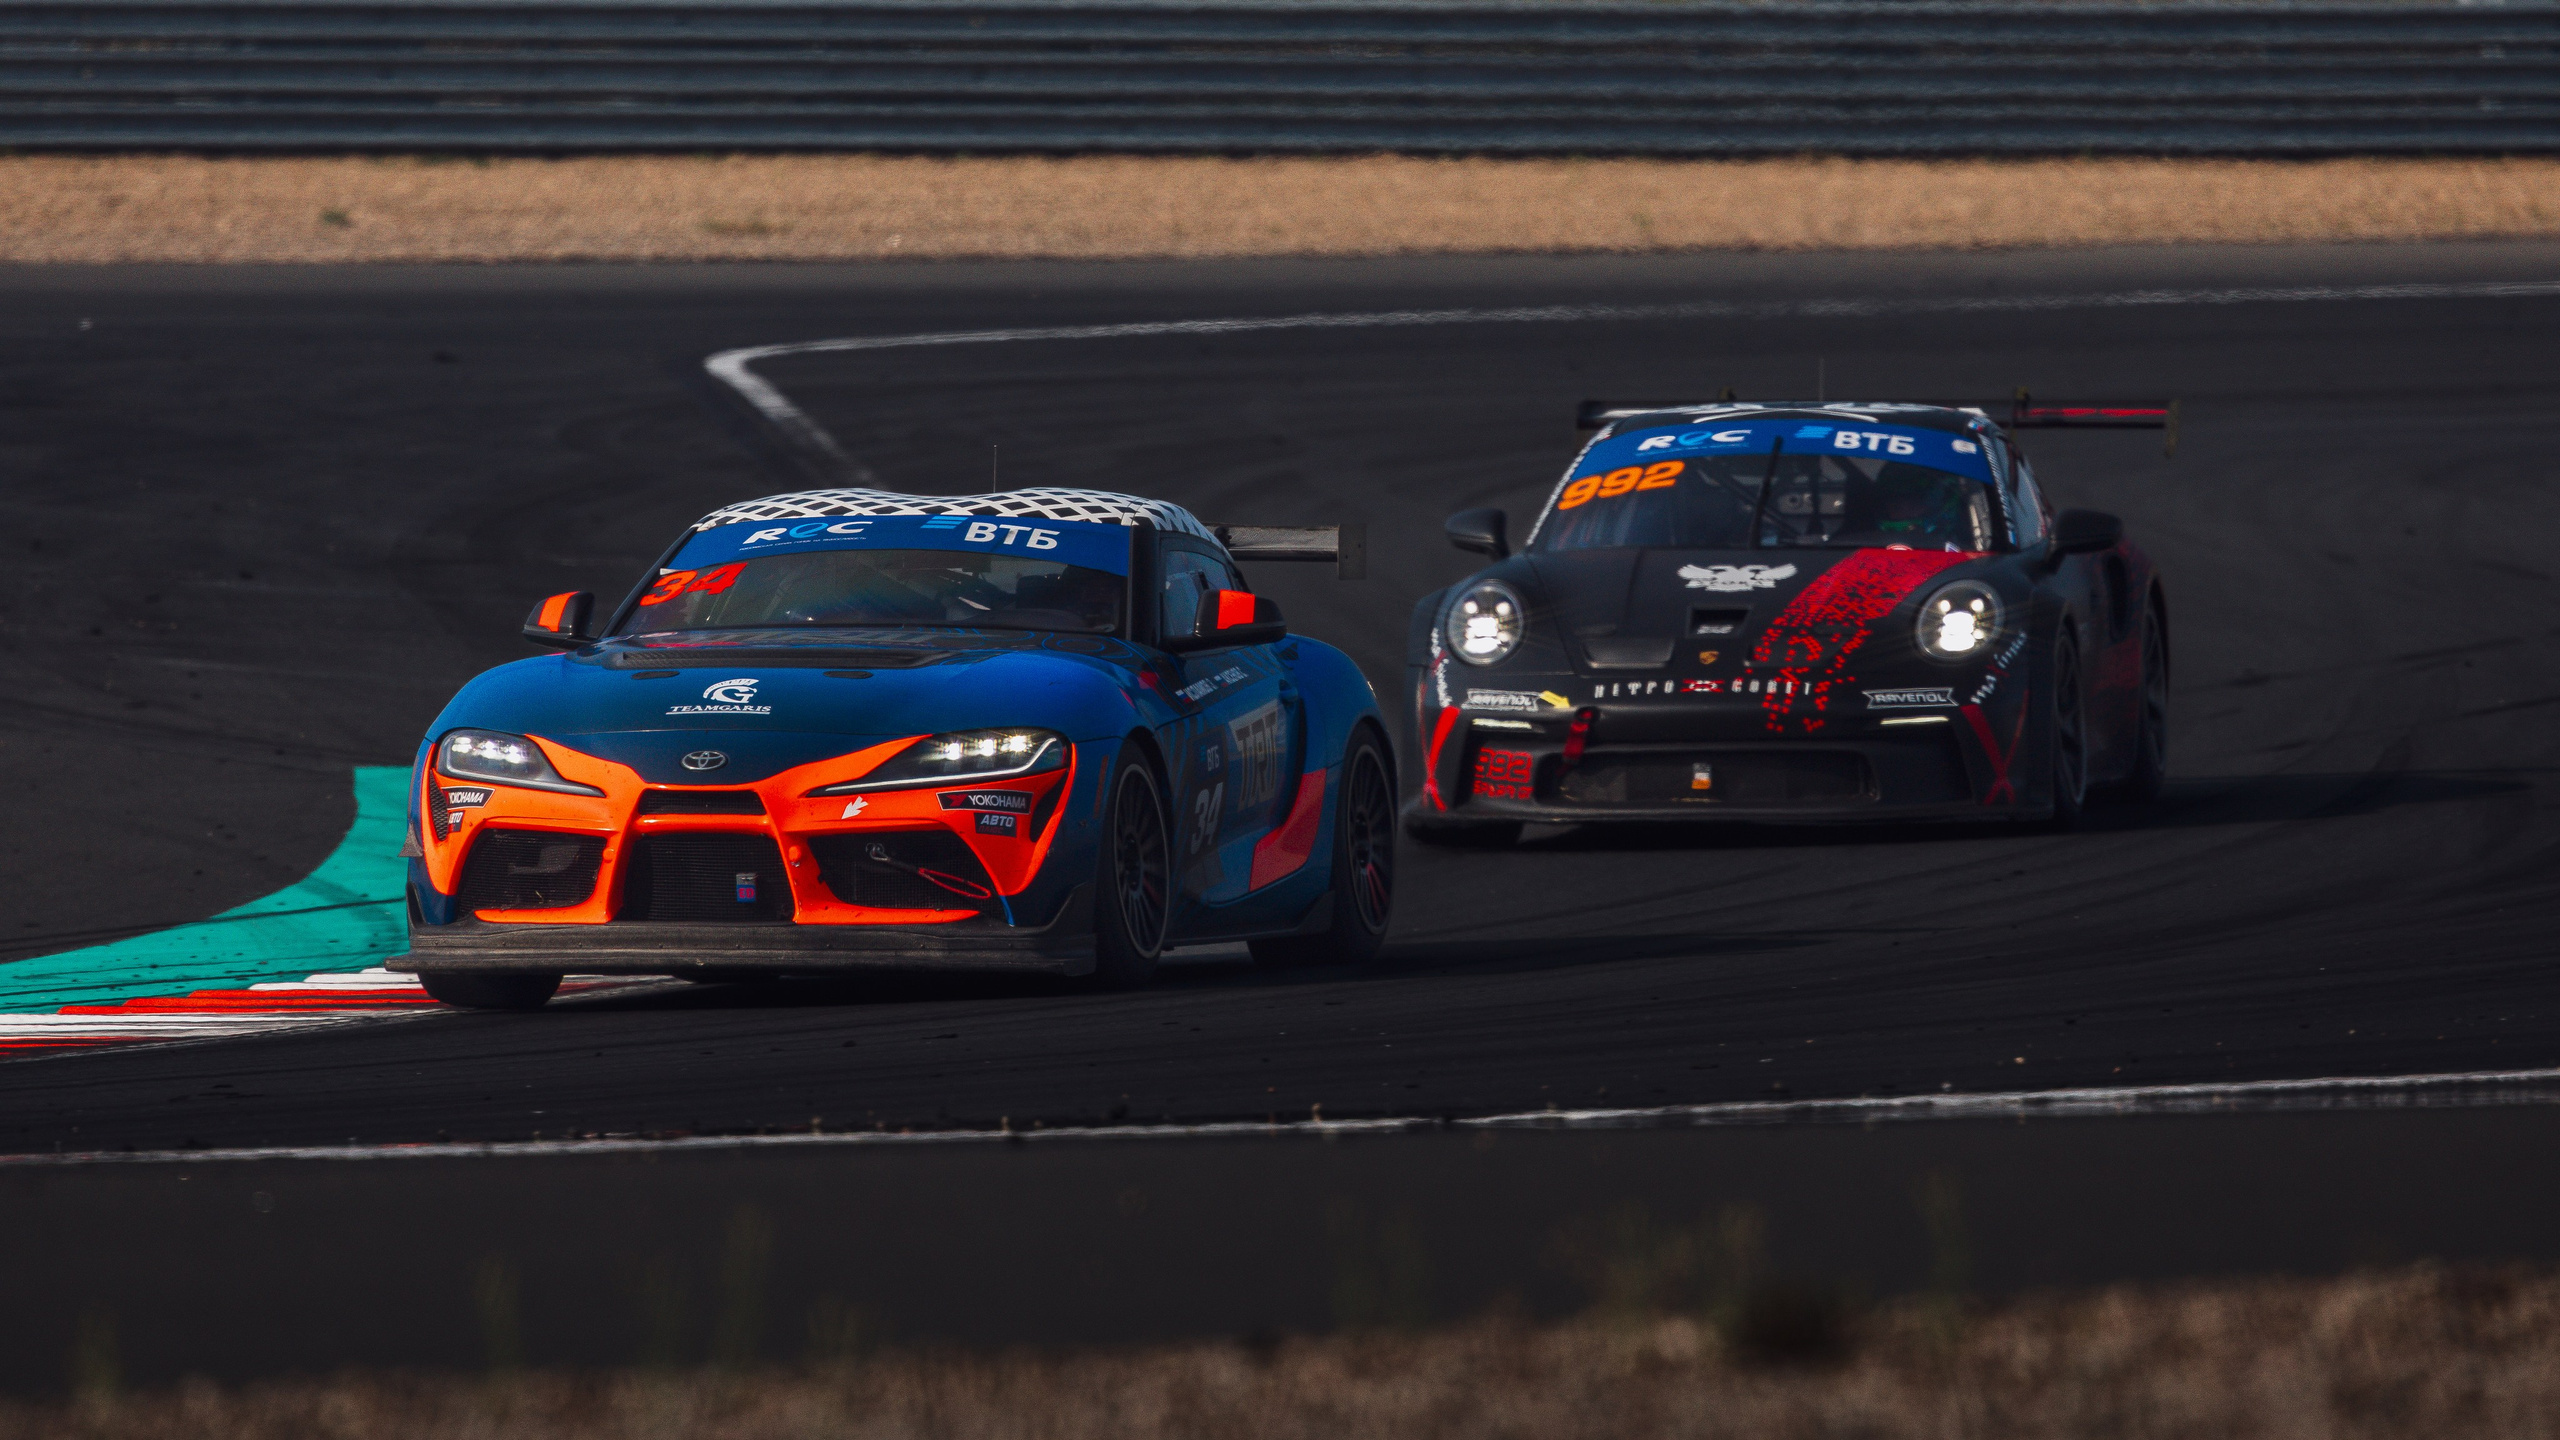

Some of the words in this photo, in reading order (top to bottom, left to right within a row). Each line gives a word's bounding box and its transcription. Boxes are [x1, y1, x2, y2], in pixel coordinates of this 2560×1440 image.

[1833, 430, 1915, 456] ВТБ
[1557, 459, 1686, 510] 992
[965, 521, 1060, 551] ВТБ
[640, 562, 749, 606] 34
[670, 704, 772, 713] TEAMGARIS
[1874, 692, 1948, 704] RAVENOL
[968, 794, 1026, 809] YOKOHAMA
[980, 814, 1014, 827] АВТО
[1190, 782, 1223, 855] 34
